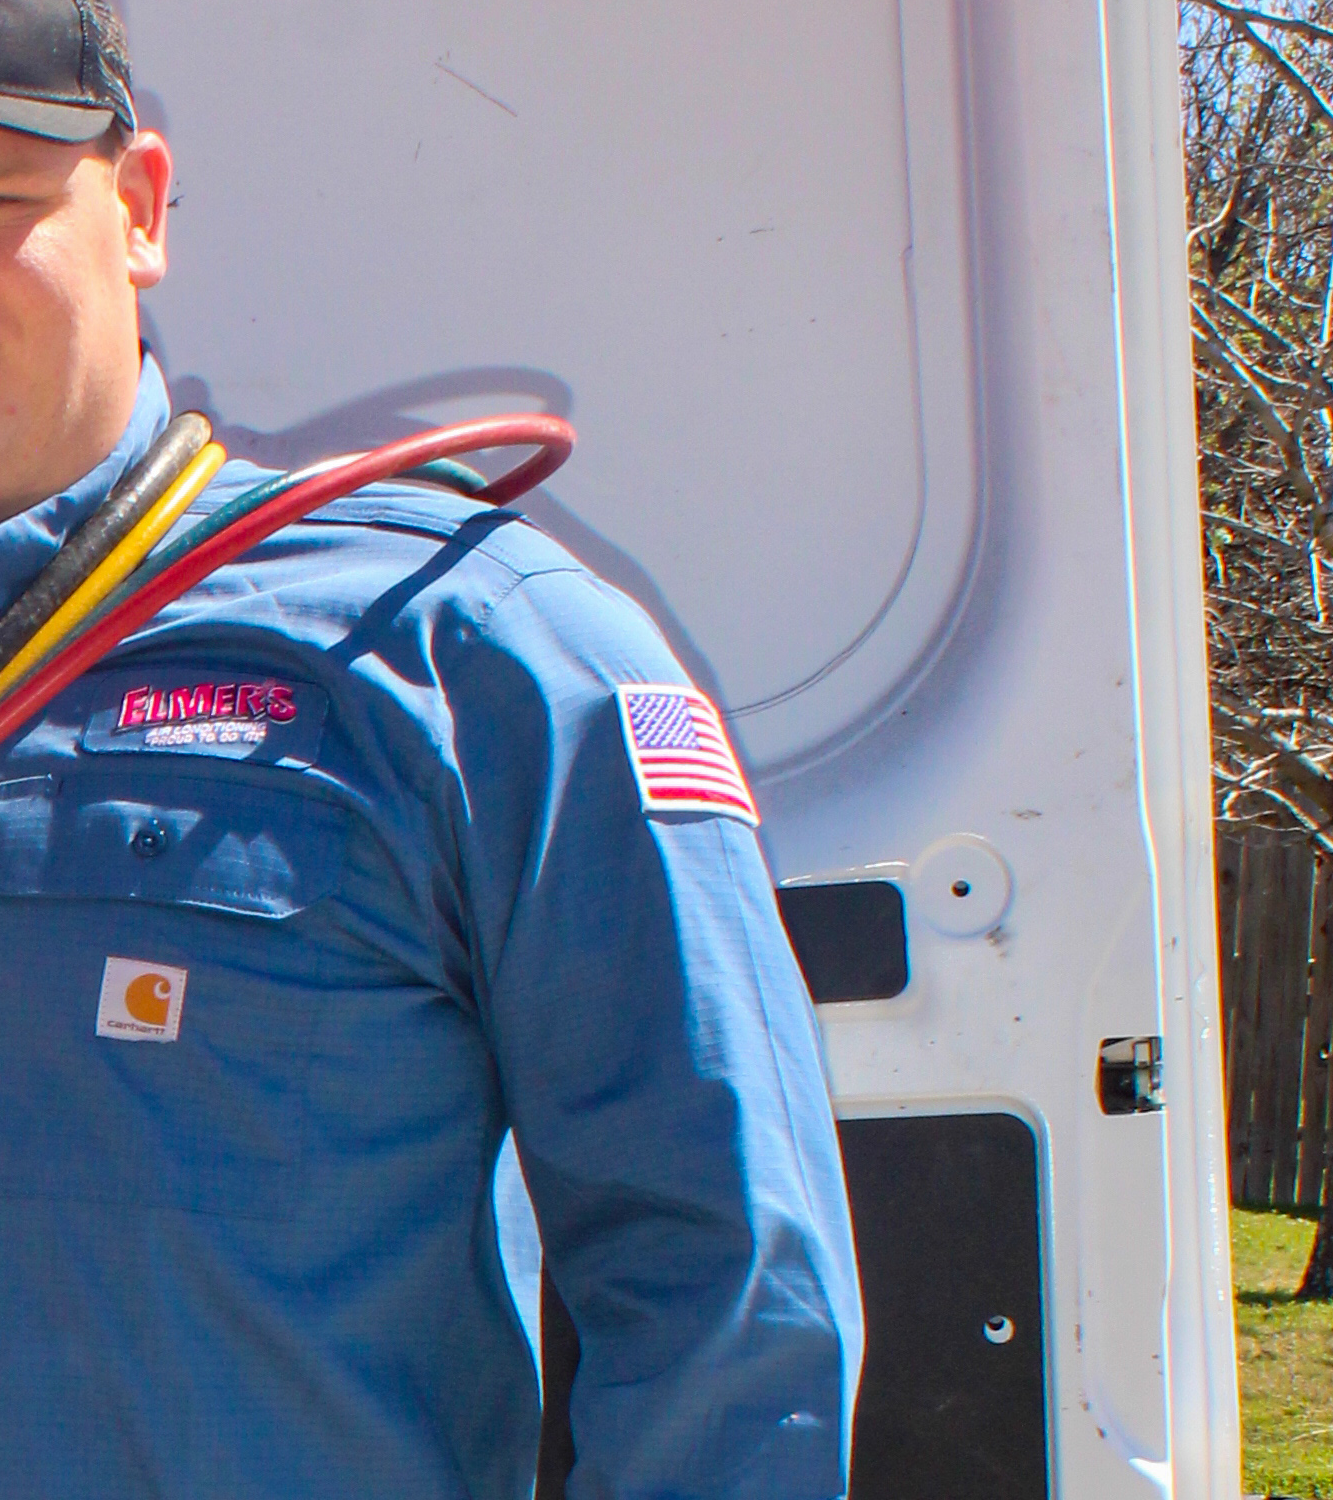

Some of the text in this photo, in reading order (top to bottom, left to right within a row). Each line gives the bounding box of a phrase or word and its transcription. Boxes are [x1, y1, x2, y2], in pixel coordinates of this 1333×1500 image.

[112, 677, 298, 734] ELMER'S
[147, 721, 268, 736] AIR CONDITIONING
[198, 732, 216, 743] TO
[218, 731, 240, 743] DO
[107, 1020, 166, 1035] carhartt
